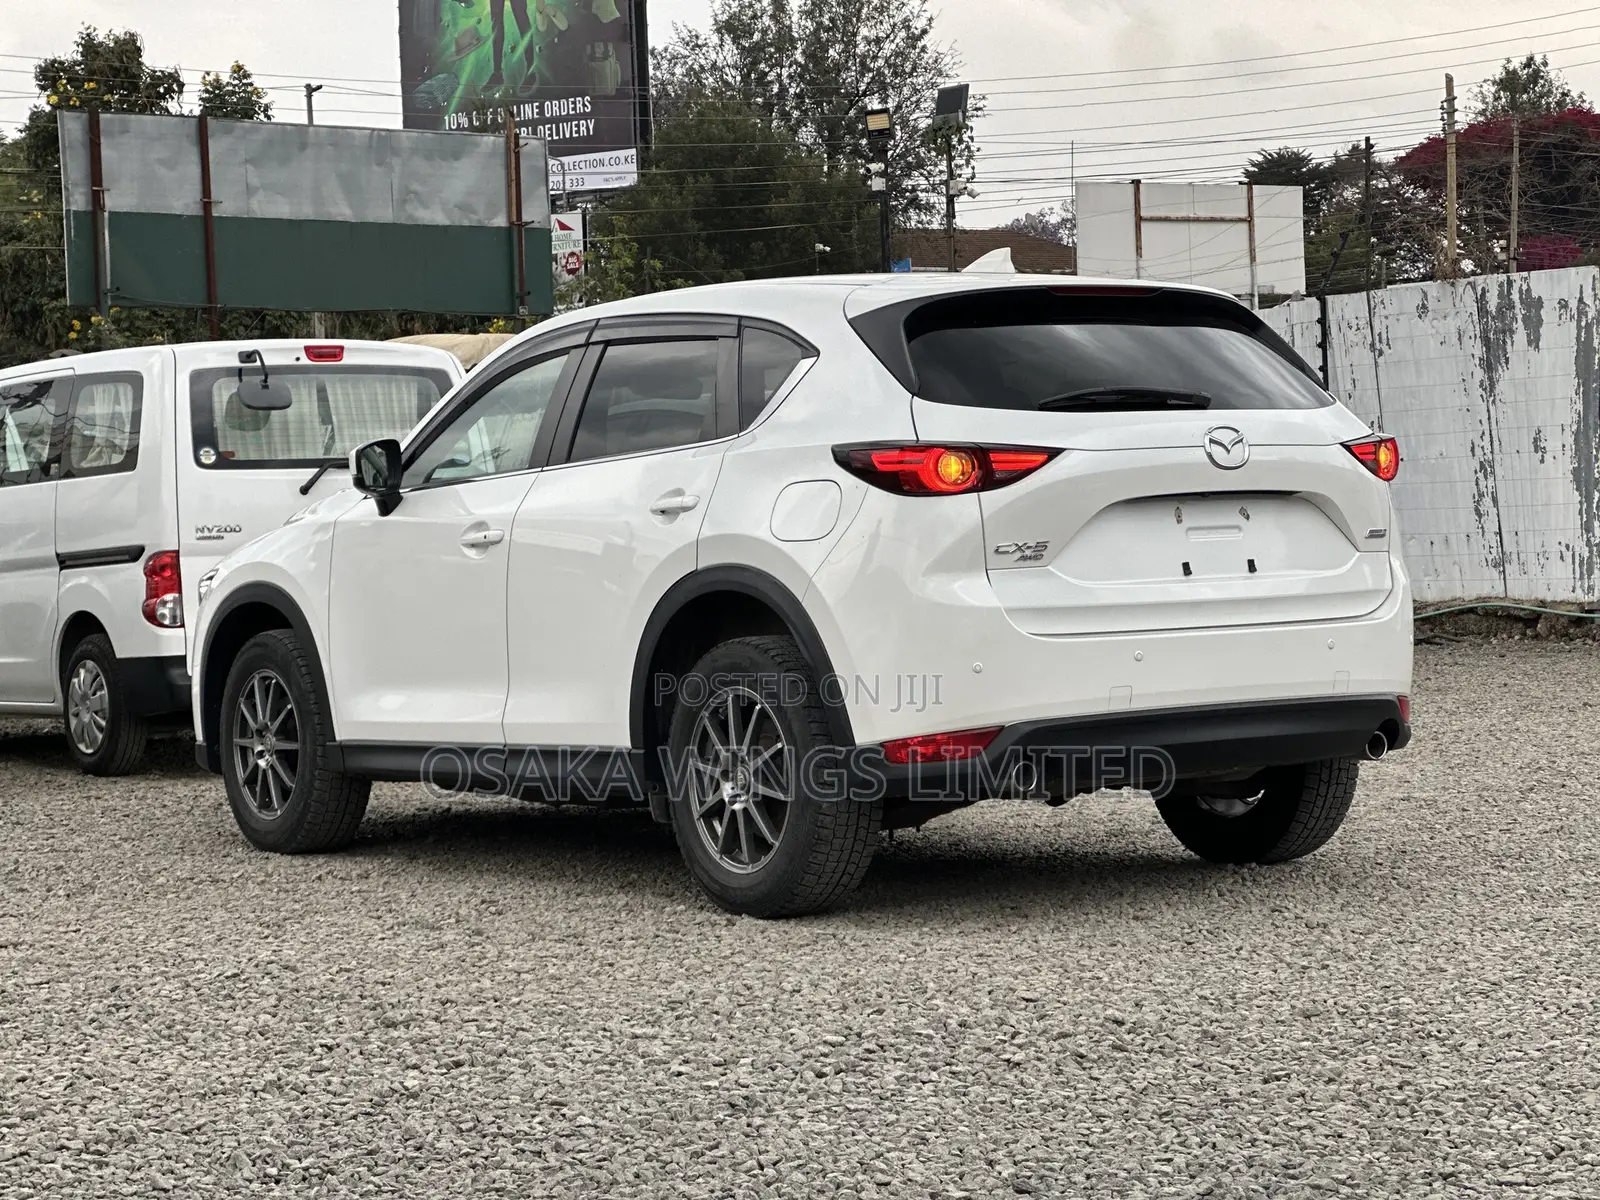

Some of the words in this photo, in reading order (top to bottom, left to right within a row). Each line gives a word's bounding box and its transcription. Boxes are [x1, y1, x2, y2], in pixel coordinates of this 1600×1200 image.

[444, 112, 469, 130] 10%
[472, 108, 493, 126] OF
[497, 102, 540, 122] OLINE
[544, 95, 592, 118] ORDERS
[568, 177, 585, 188] 333
[554, 232, 573, 241] HOME
[195, 525, 242, 534] NV200
[994, 540, 1050, 554] CX-5
[1014, 553, 1044, 562] AWD
